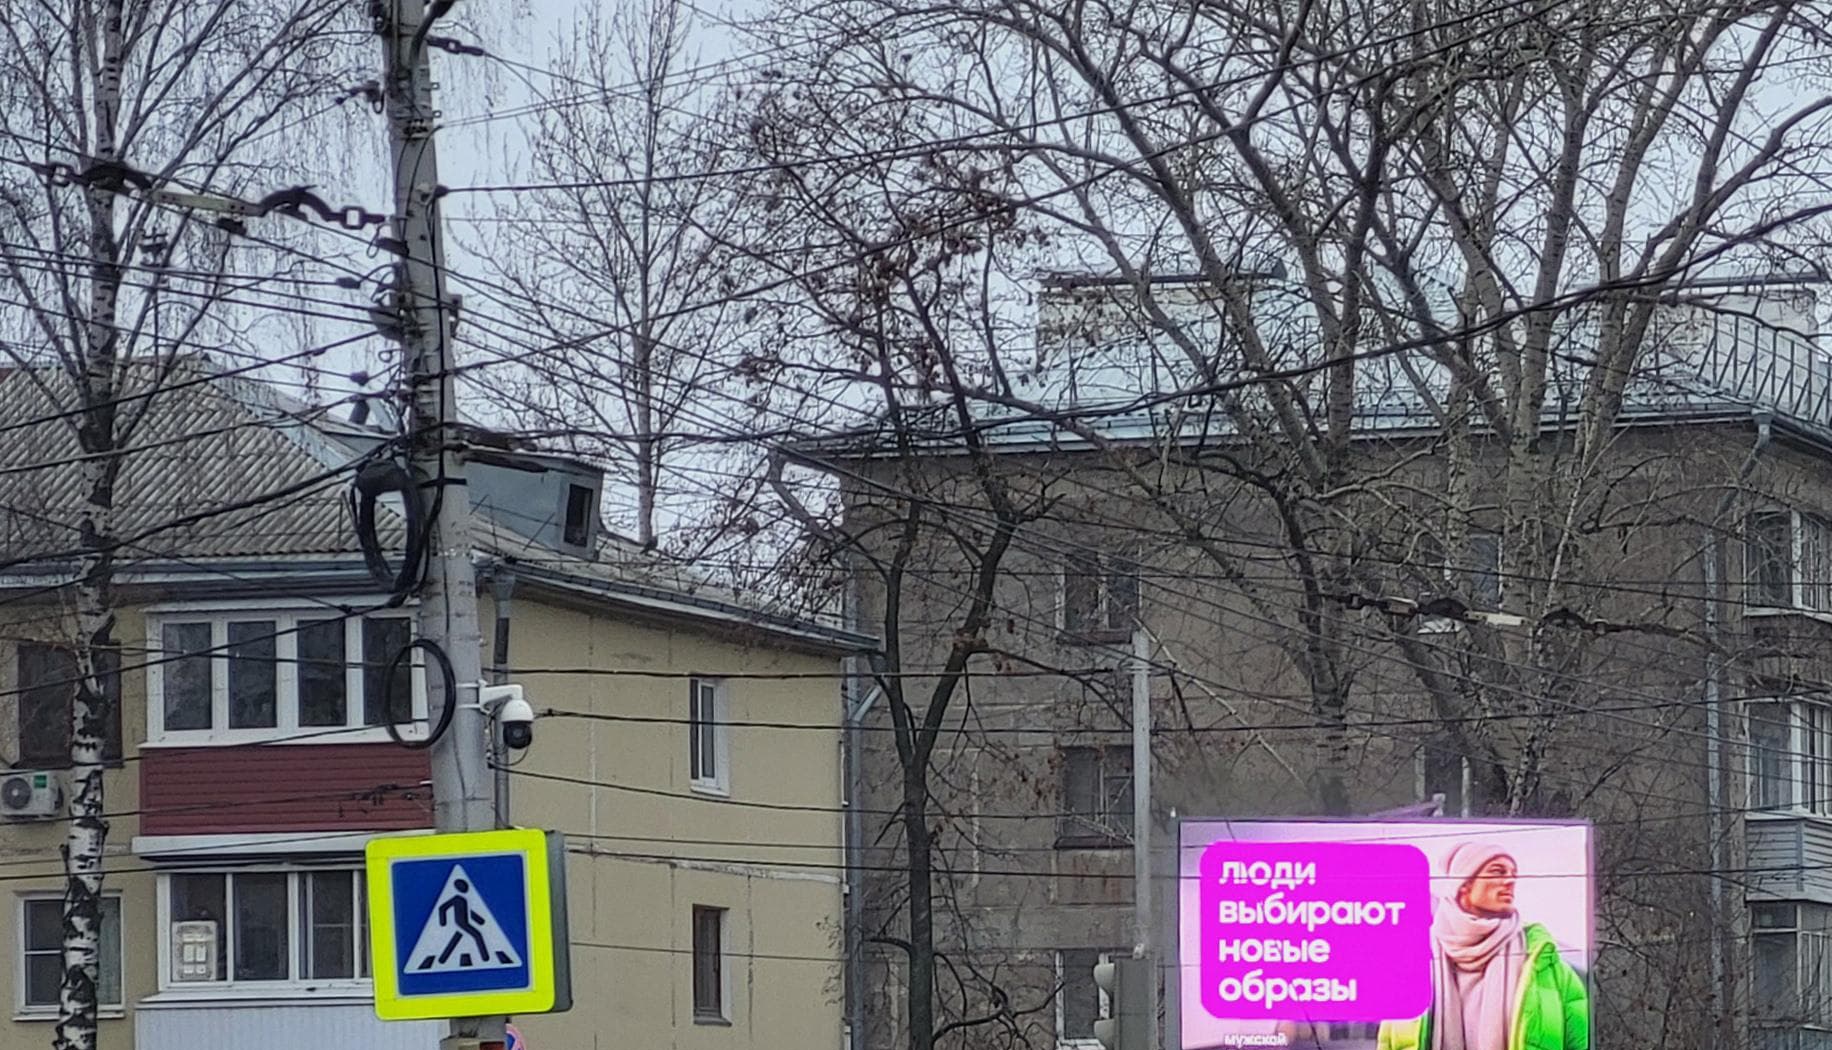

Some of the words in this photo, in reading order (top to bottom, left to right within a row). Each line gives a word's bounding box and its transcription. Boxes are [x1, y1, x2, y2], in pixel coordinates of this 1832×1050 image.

[1218, 860, 1317, 890] люди
[1218, 892, 1406, 932] выбирают
[1218, 938, 1331, 964] новые
[1218, 969, 1357, 1009] образы
